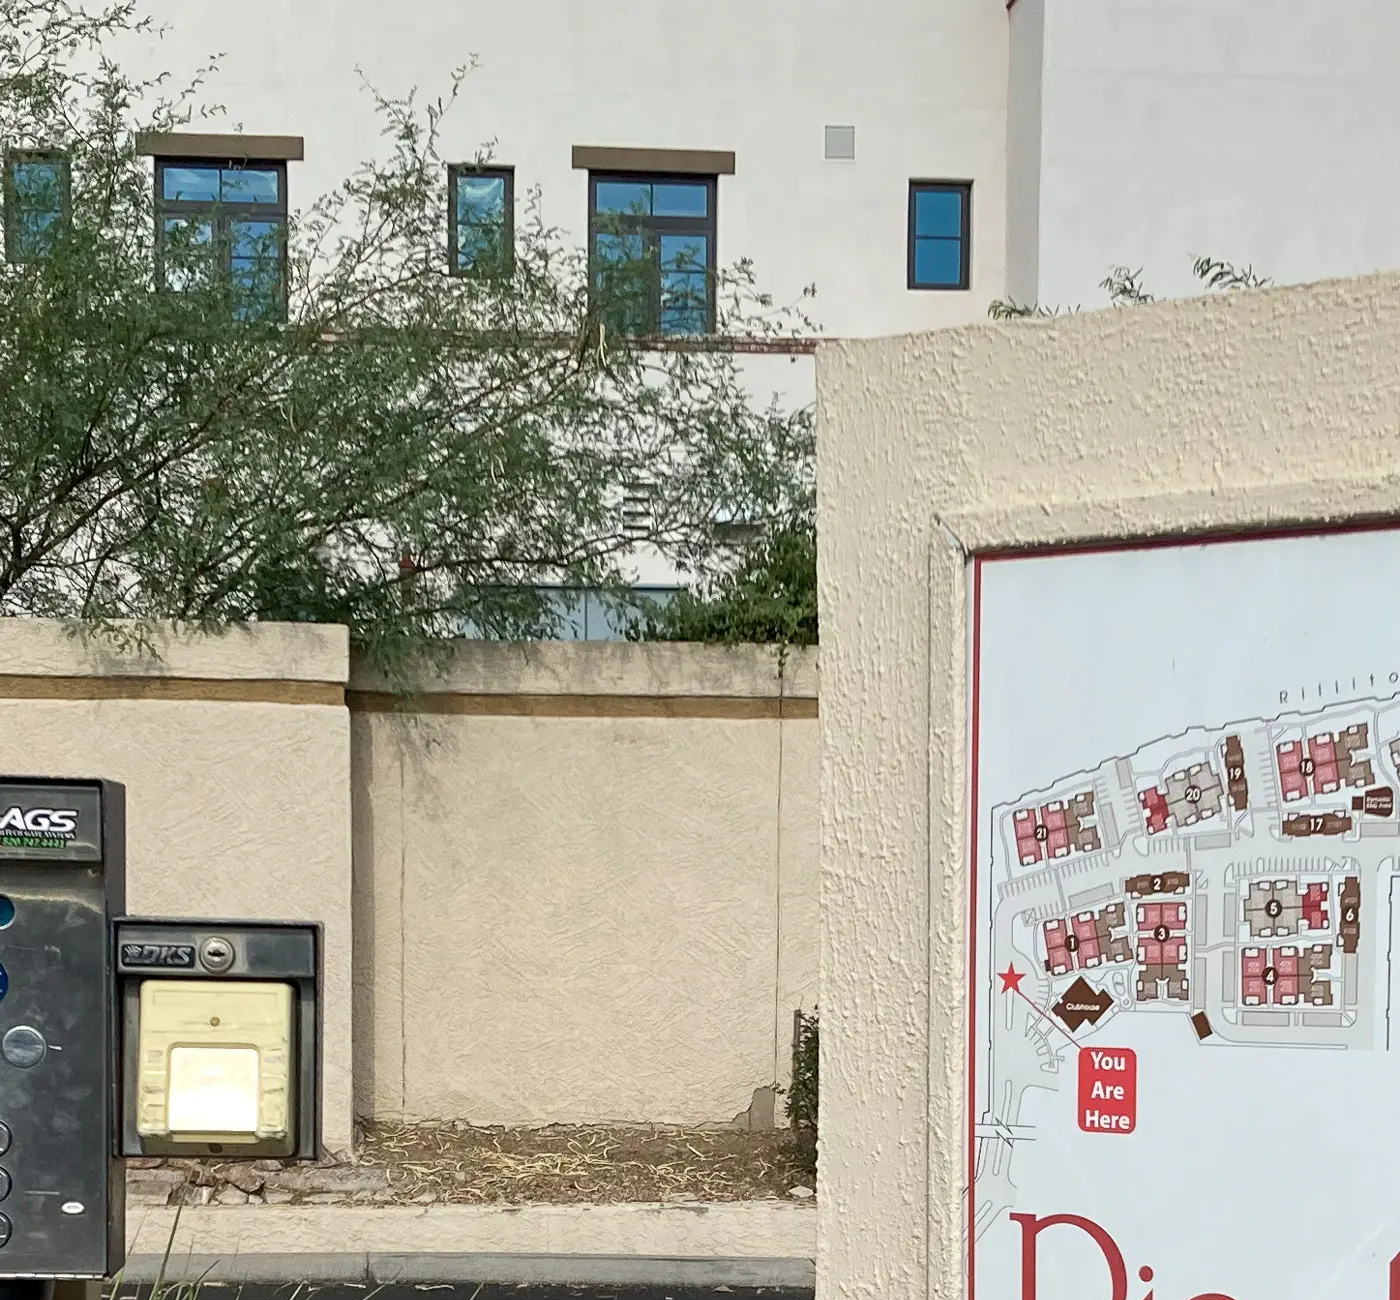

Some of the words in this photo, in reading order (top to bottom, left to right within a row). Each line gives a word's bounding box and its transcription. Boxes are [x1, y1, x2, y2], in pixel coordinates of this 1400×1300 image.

[1279, 672, 1399, 704] Rillito
[1229, 768, 1241, 780] 19
[1300, 762, 1313, 773] 18
[1185, 788, 1200, 801] 20
[0, 807, 77, 832] AGS
[1310, 818, 1323, 832] 17
[1036, 827, 1047, 839] 21
[1153, 878, 1162, 891] 2
[1271, 902, 1278, 915] 5
[1345, 908, 1354, 922] 6
[1158, 927, 1166, 942] 3
[1266, 970, 1274, 983] 4
[1066, 1003, 1100, 1012] Clubhouse
[1090, 1051, 1125, 1071] You
[1091, 1080, 1124, 1100] Are
[1085, 1109, 1130, 1130] Here
